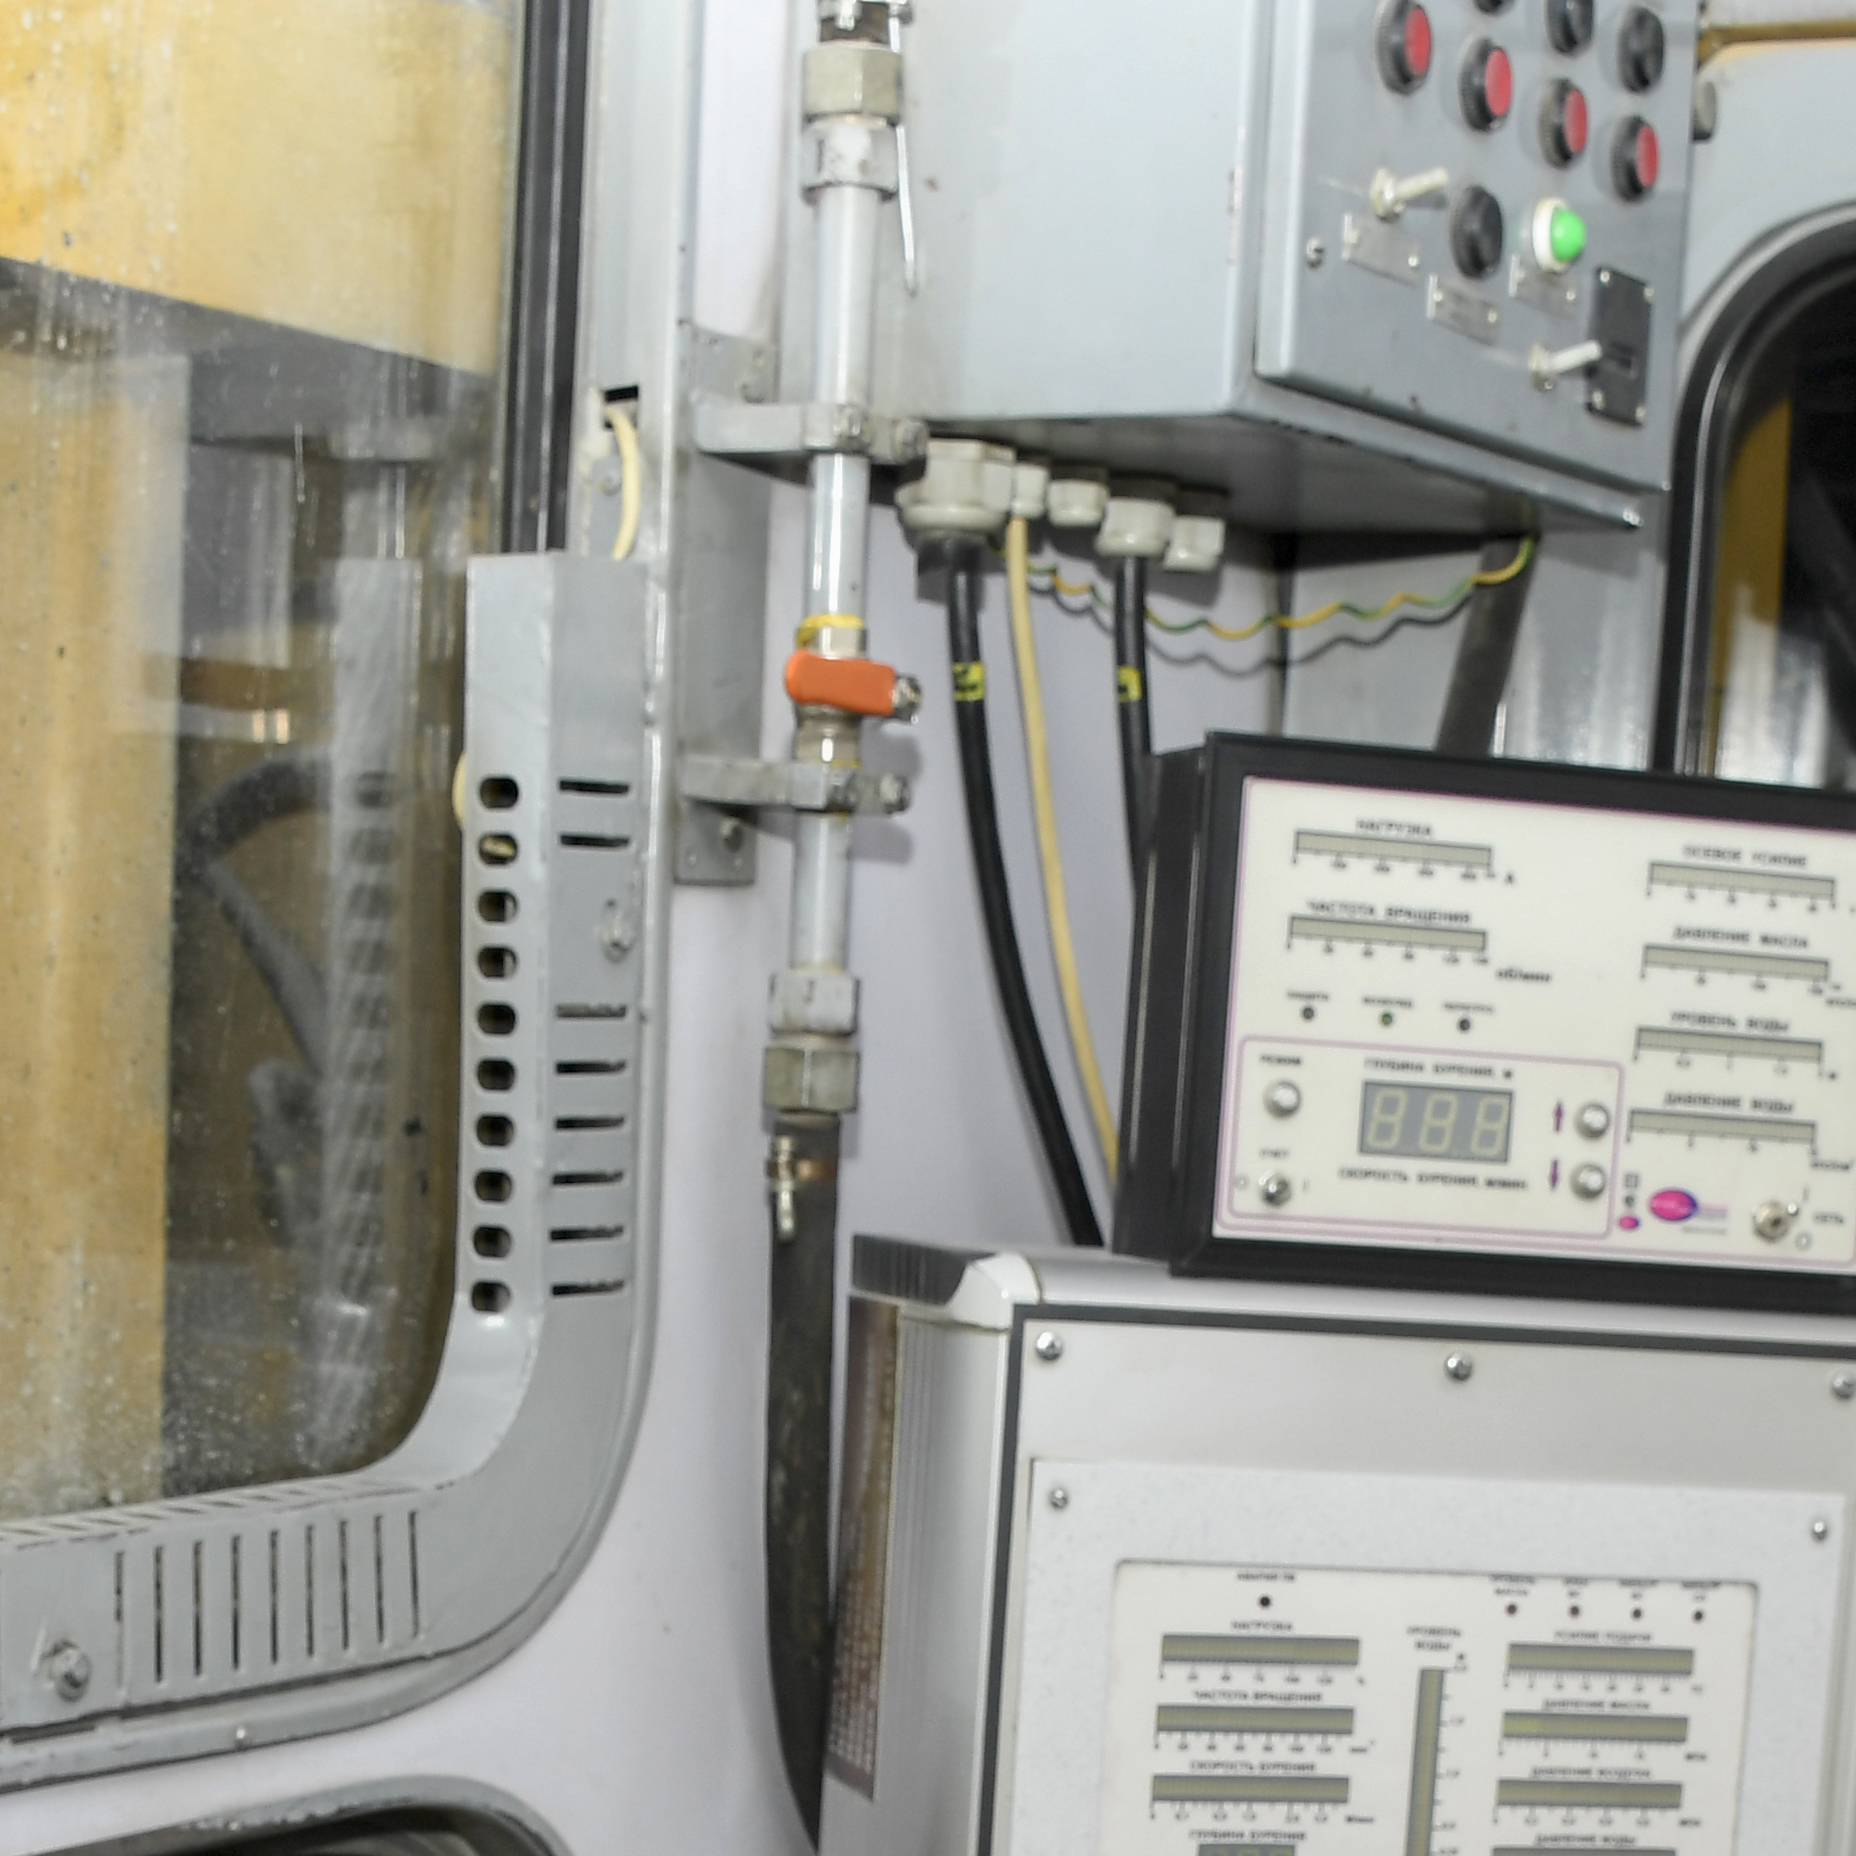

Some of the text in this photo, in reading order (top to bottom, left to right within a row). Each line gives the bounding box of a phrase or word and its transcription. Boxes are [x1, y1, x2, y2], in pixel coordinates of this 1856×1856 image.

[1307, 899, 1375, 917] ЧАСТОТА
[1673, 926, 1750, 942] ДАВЛЕНИЕ
[1670, 1012, 1789, 1031] УРОВЕНЬ ВОДЫ
[1665, 1092, 1794, 1112] ДАВЛЕНИЕ ВОДЫ
